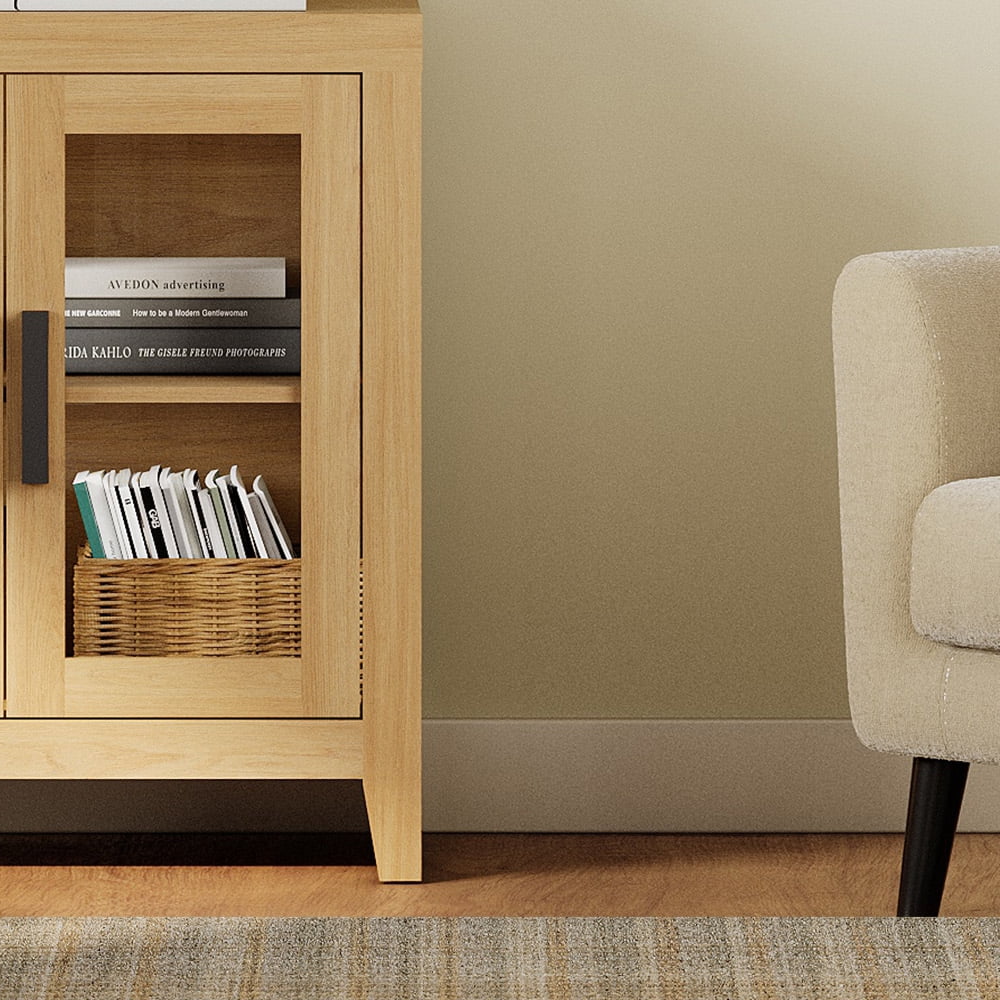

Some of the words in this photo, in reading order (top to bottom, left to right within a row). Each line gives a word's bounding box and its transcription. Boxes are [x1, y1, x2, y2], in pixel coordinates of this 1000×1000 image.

[108, 279, 159, 290] AVEDON
[162, 279, 225, 292] advertising
[71, 309, 86, 317] NEW
[132, 309, 148, 317] How
[149, 309, 157, 317] to
[158, 309, 167, 317] be
[174, 309, 200, 317] Modern
[201, 309, 248, 317] Gentlewoman
[92, 346, 132, 359] KAHLO
[138, 348, 156, 357] THE
[157, 348, 188, 357] GISELE
[189, 348, 224, 357] FREUND
[225, 348, 287, 357] PHOTOGRAPHS
